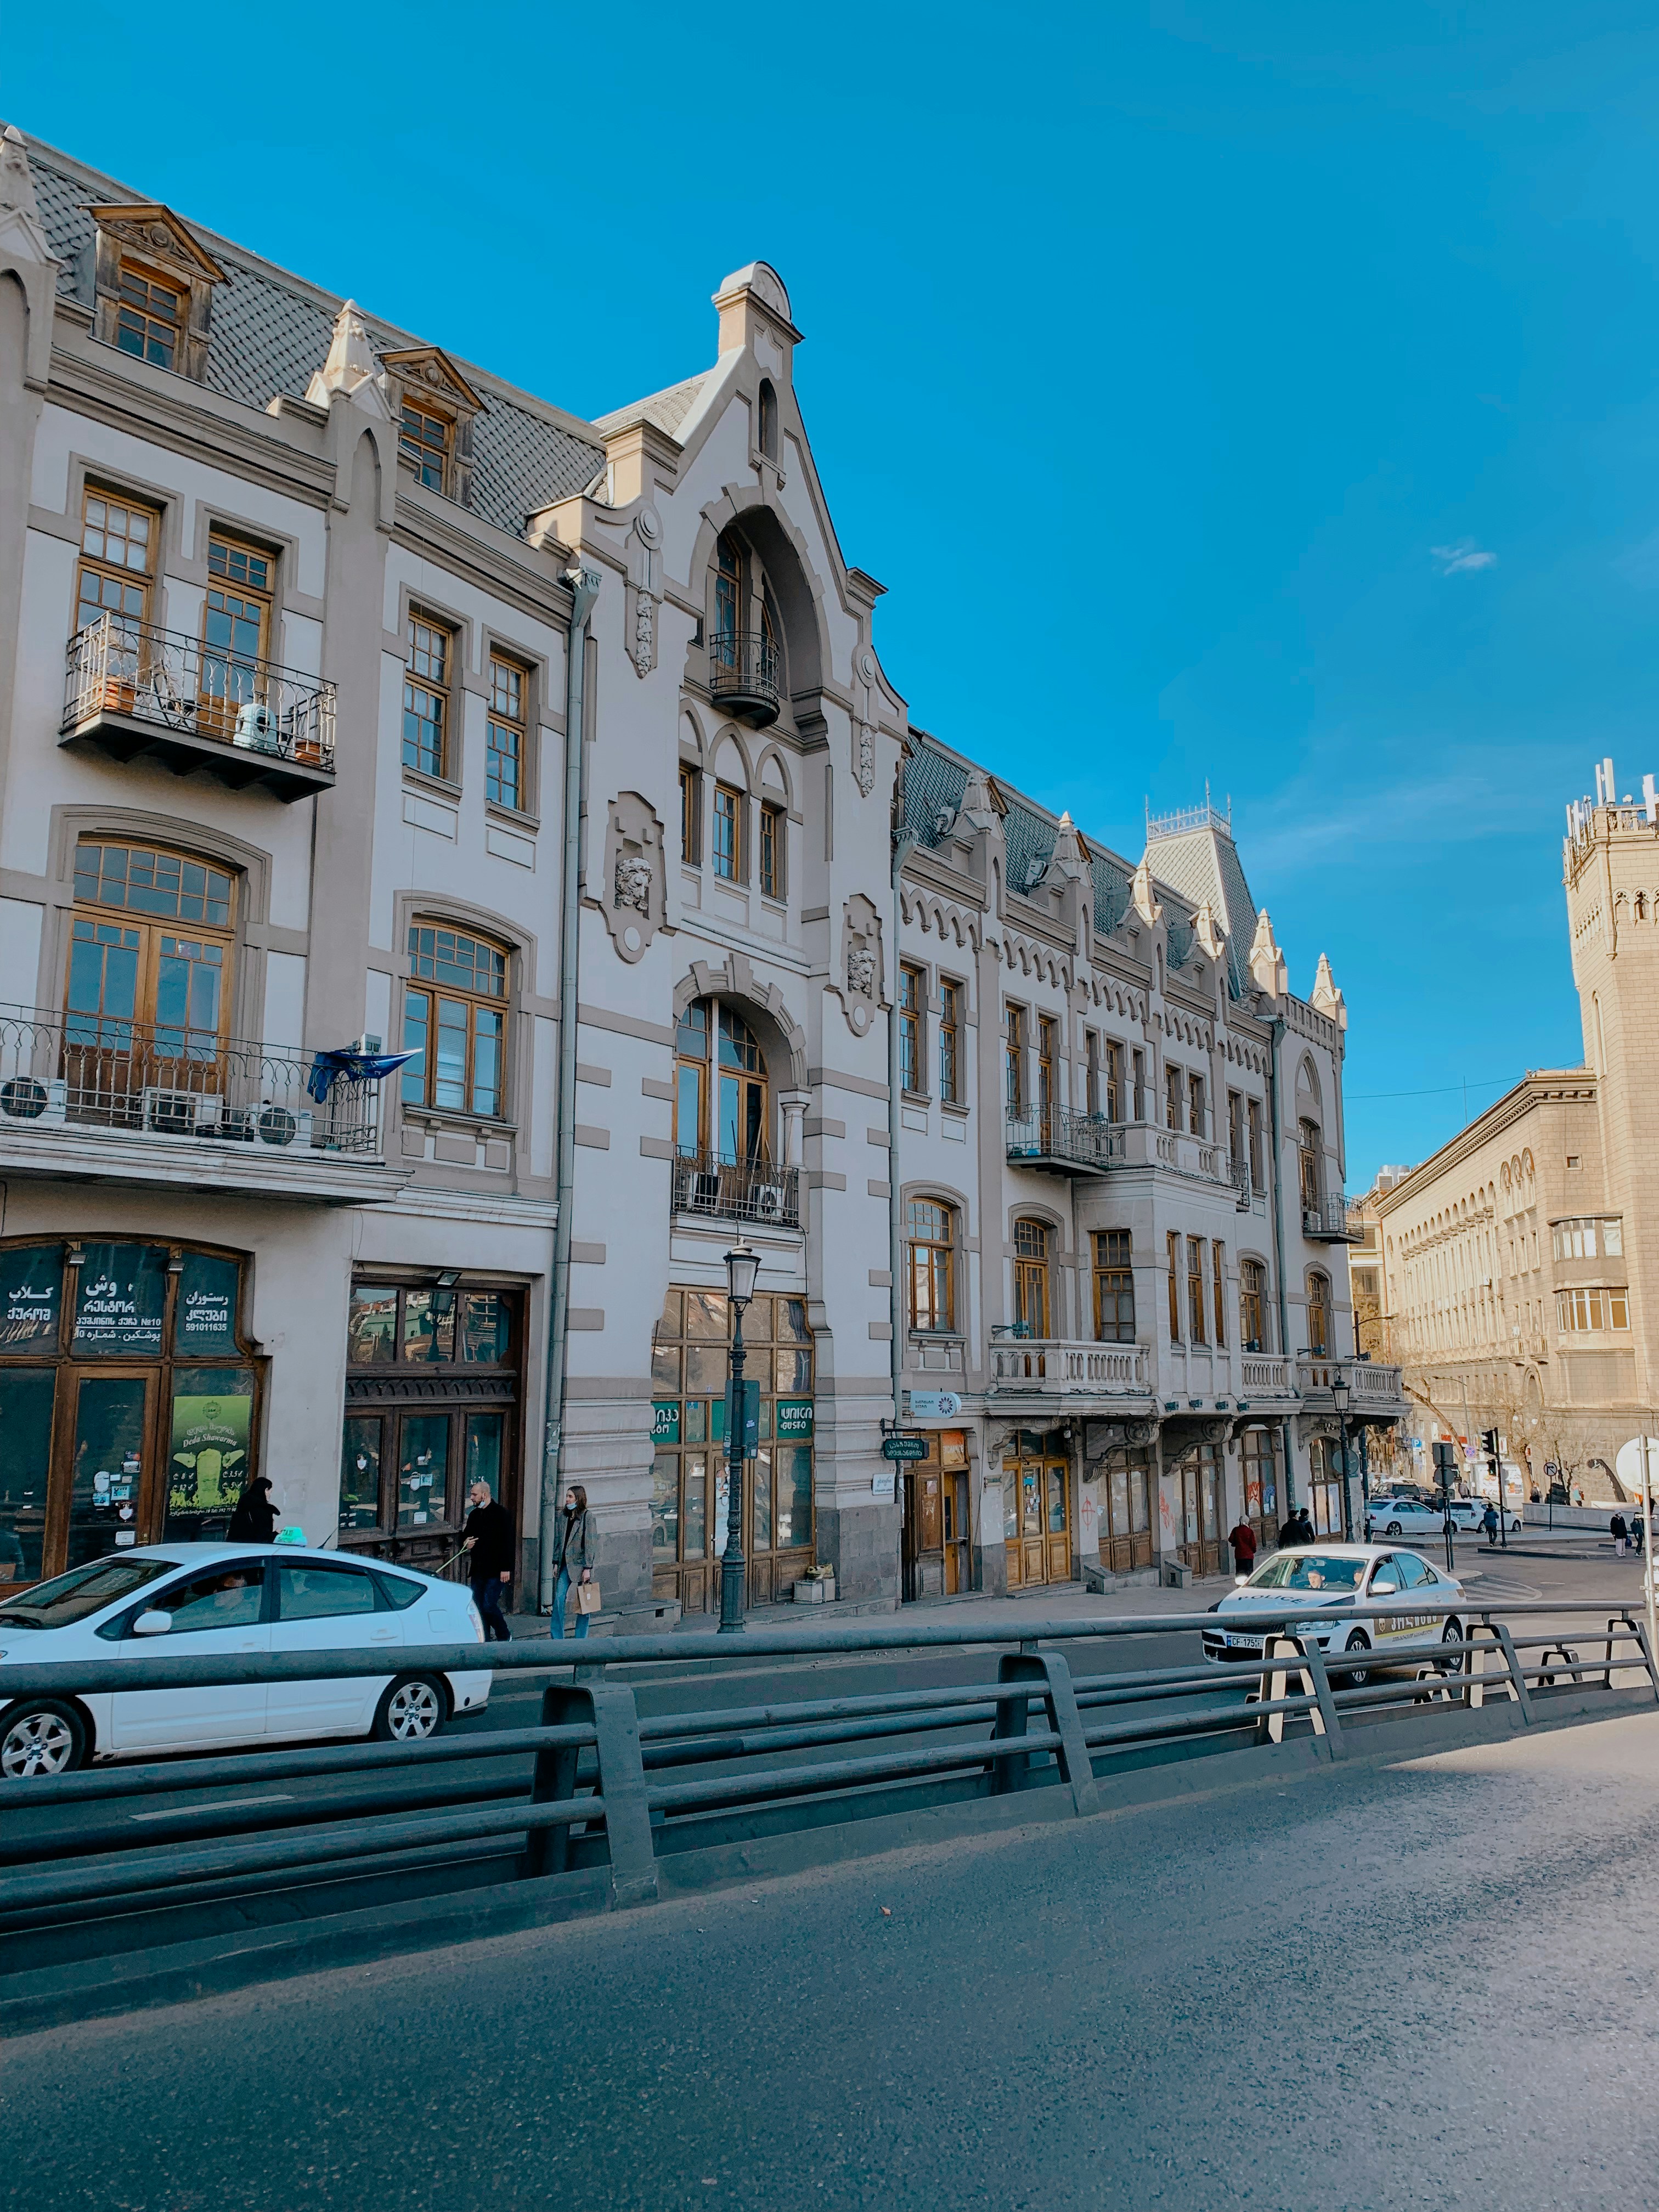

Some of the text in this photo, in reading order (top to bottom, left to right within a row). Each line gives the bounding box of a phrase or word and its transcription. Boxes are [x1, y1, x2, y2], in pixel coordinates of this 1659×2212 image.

[185, 1309, 228, 1322] კლუბი
[185, 1323, 227, 1331] 591011635
[780, 1421, 806, 1430] GUSTO
[183, 1433, 238, 1448] Deda Shawarma
[1238, 1594, 1306, 1604] POLICE
